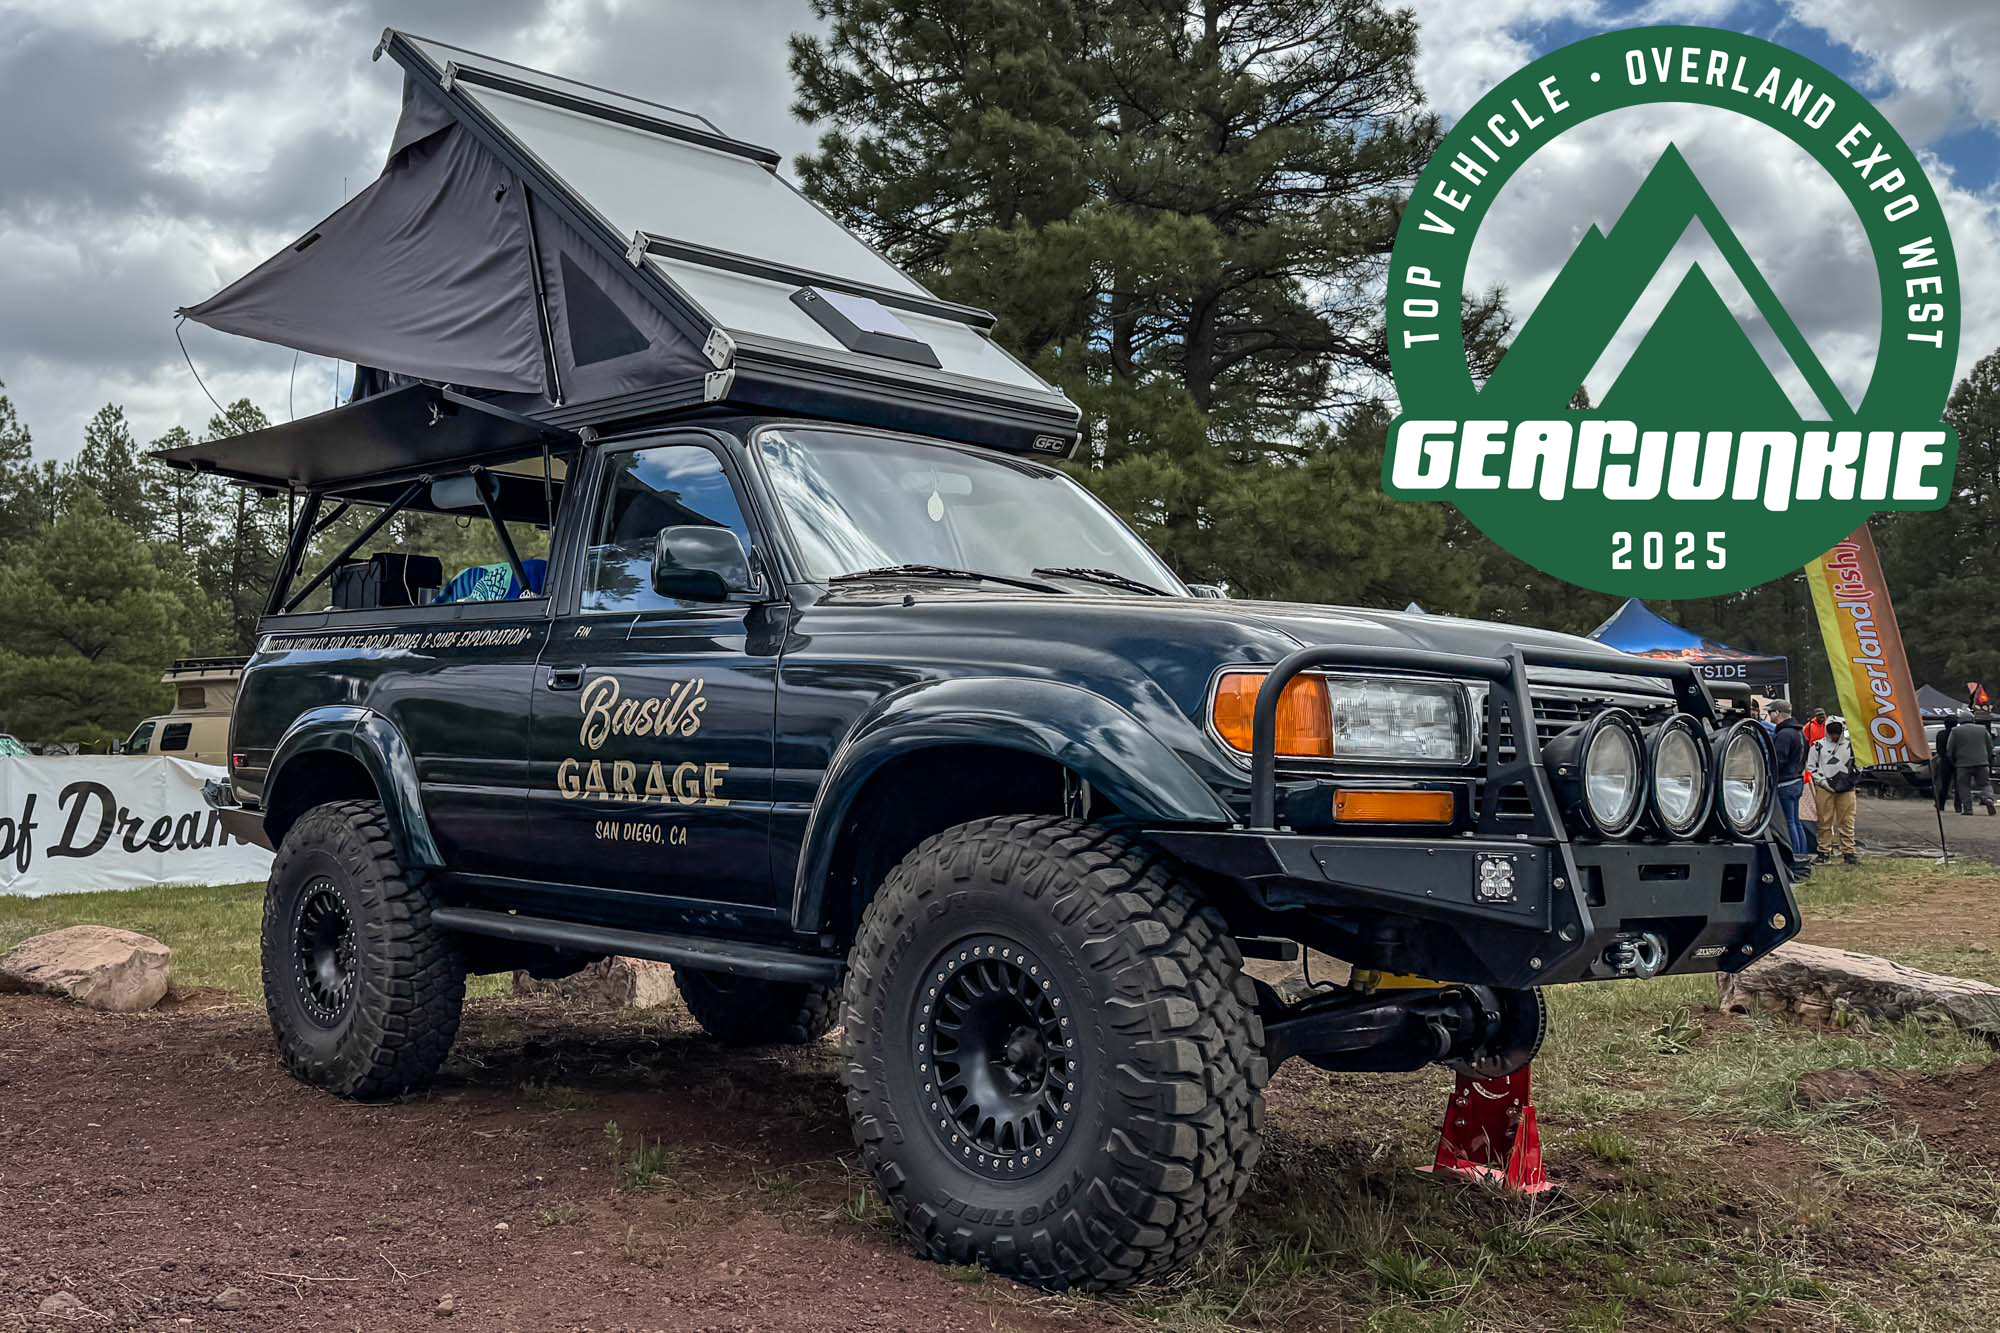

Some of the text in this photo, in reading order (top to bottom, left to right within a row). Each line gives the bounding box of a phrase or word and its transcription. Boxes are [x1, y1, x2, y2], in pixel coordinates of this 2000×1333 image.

[1035, 437, 1063, 450] GFC
[326, 635, 347, 650] FOR
[345, 633, 391, 649] OFF-ROAD
[388, 632, 423, 649] TRAVEL
[430, 631, 460, 648] SURF
[456, 627, 529, 648] EXPLORATION
[574, 626, 593, 638] FIN
[579, 675, 708, 750] Basil's
[557, 757, 731, 807] GARAGE
[594, 820, 688, 846] SAN DIEGO, CA
